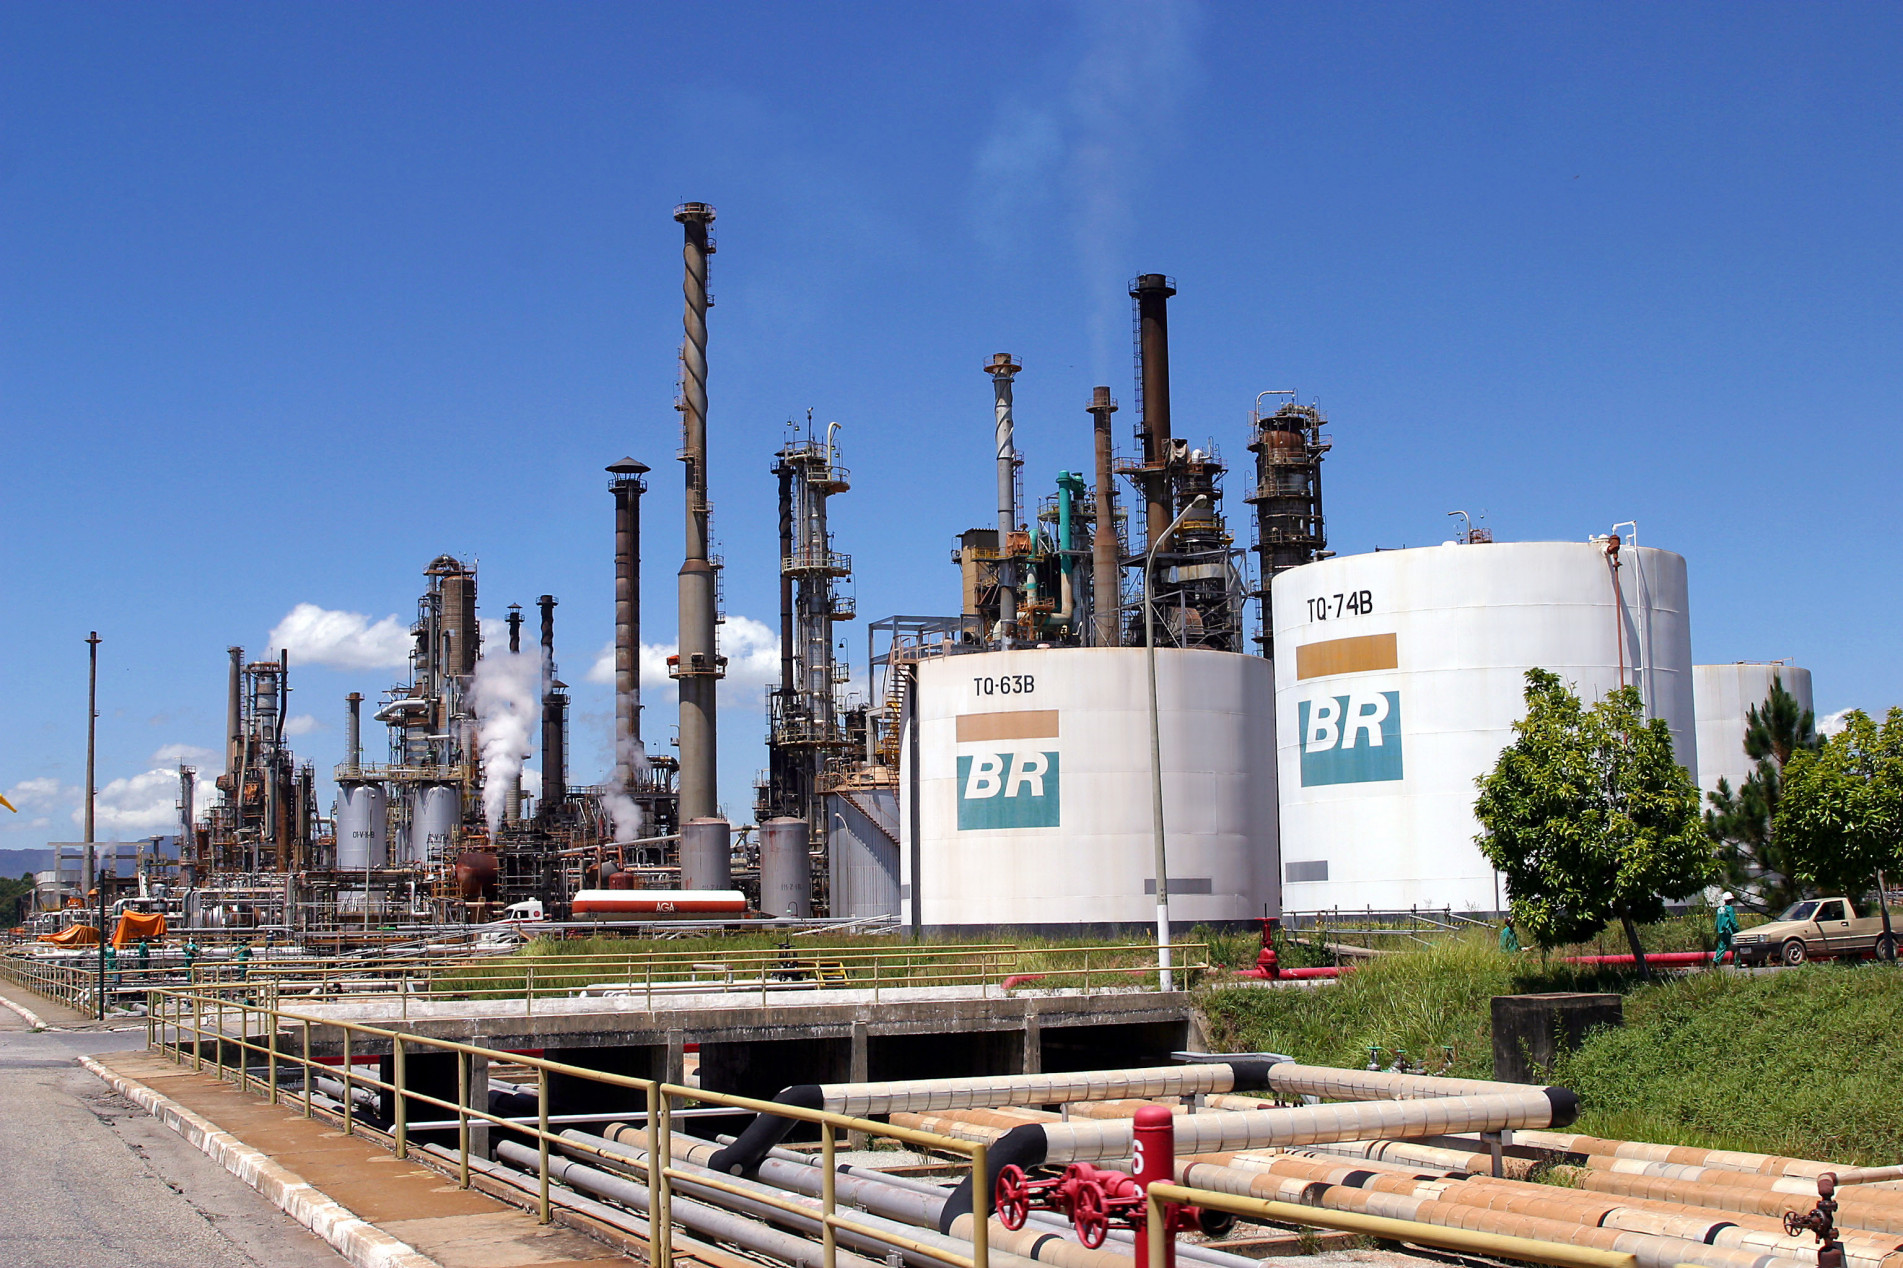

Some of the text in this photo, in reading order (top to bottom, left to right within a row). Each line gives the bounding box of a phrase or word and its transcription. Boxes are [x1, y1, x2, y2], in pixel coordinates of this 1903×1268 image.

[1307, 590, 1373, 623] TQ-74B
[974, 675, 1035, 696] TQ-63B
[1305, 692, 1390, 754] BR
[964, 751, 1049, 800] BR
[655, 901, 675, 913] AGA
